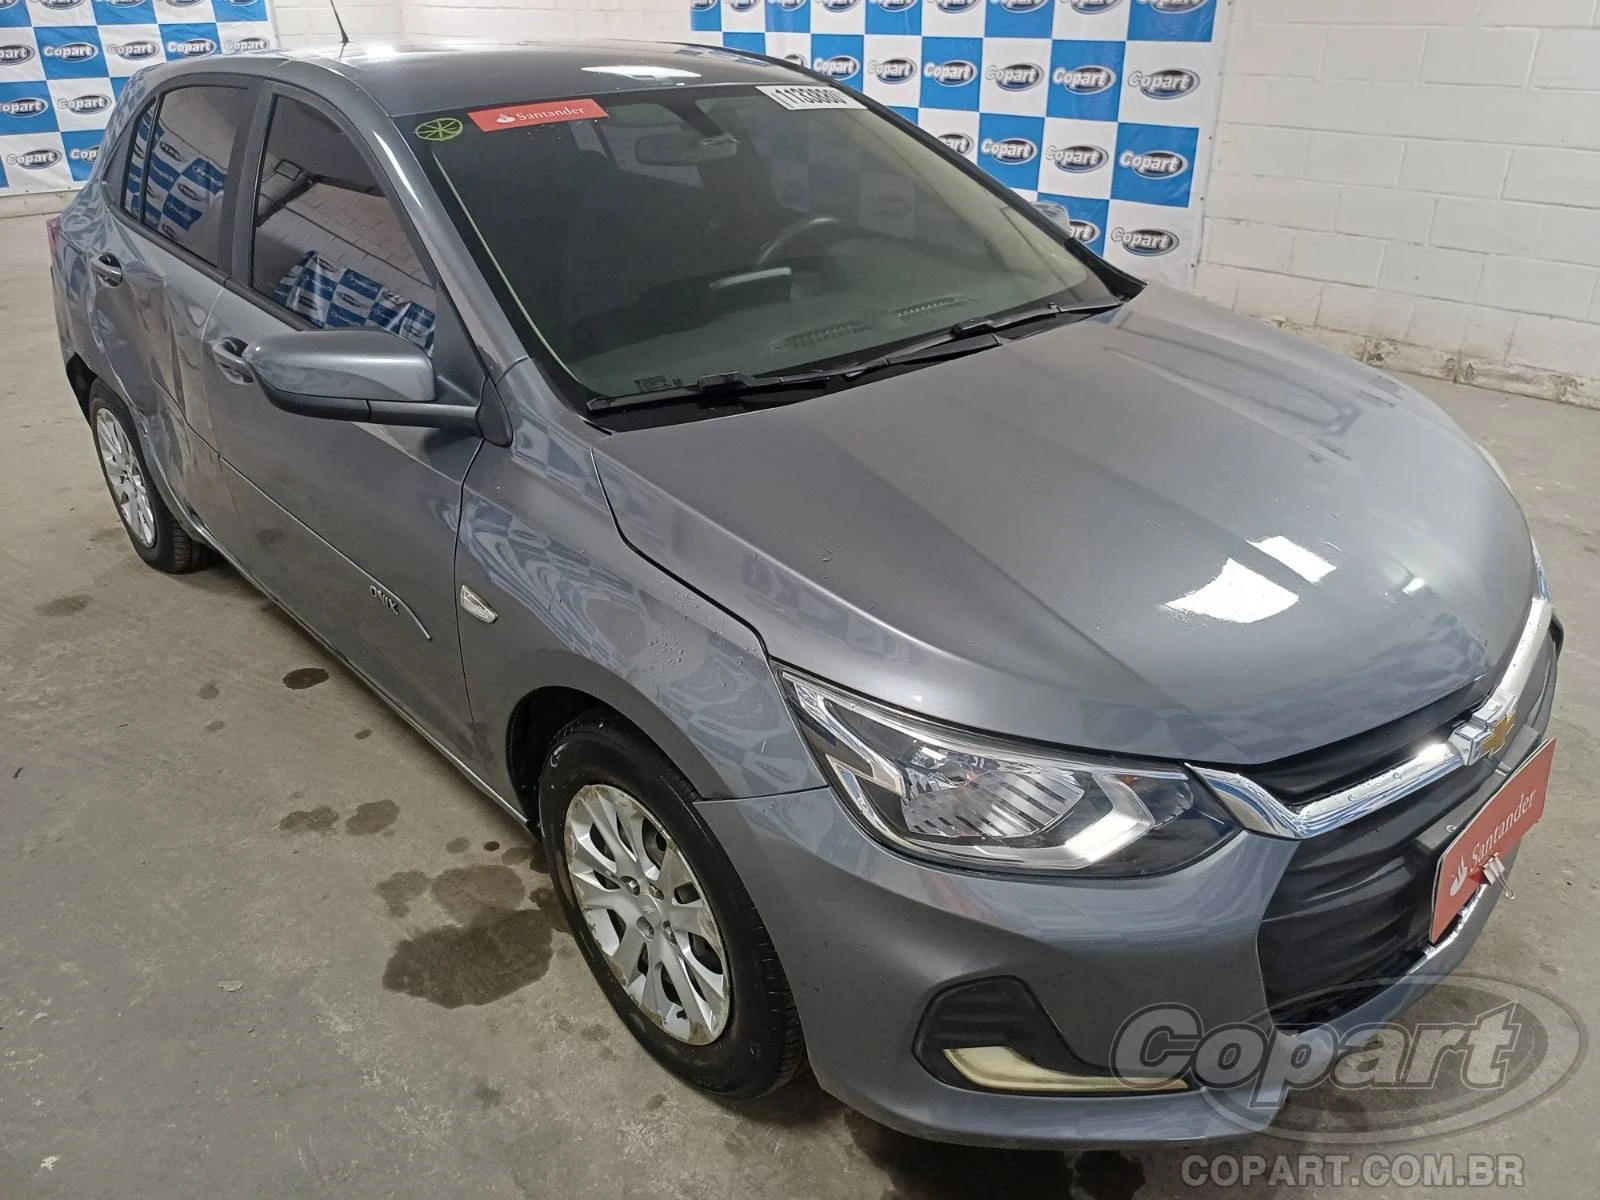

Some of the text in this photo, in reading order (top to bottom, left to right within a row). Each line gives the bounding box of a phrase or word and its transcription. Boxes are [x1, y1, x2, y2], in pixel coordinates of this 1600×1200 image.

[44, 46, 92, 58] Copart
[107, 43, 153, 56] Copart
[167, 41, 212, 54] Copart
[224, 39, 265, 52] Copart
[813, 58, 854, 74] Copart
[868, 60, 911, 79] Copart
[924, 61, 972, 81] Copart
[985, 65, 1037, 85] Copart
[1052, 67, 1107, 89] Copart
[1128, 71, 1189, 93] Copart
[58, 98, 105, 111] Copart
[517, 106, 584, 121] Santander
[981, 139, 1030, 159] Copart
[1046, 145, 1099, 166] Copart
[7, 153, 54, 167] Copart
[1119, 151, 1178, 174] Copart
[1111, 227, 1168, 250] Copart
[1471, 788, 1536, 868] Santander
